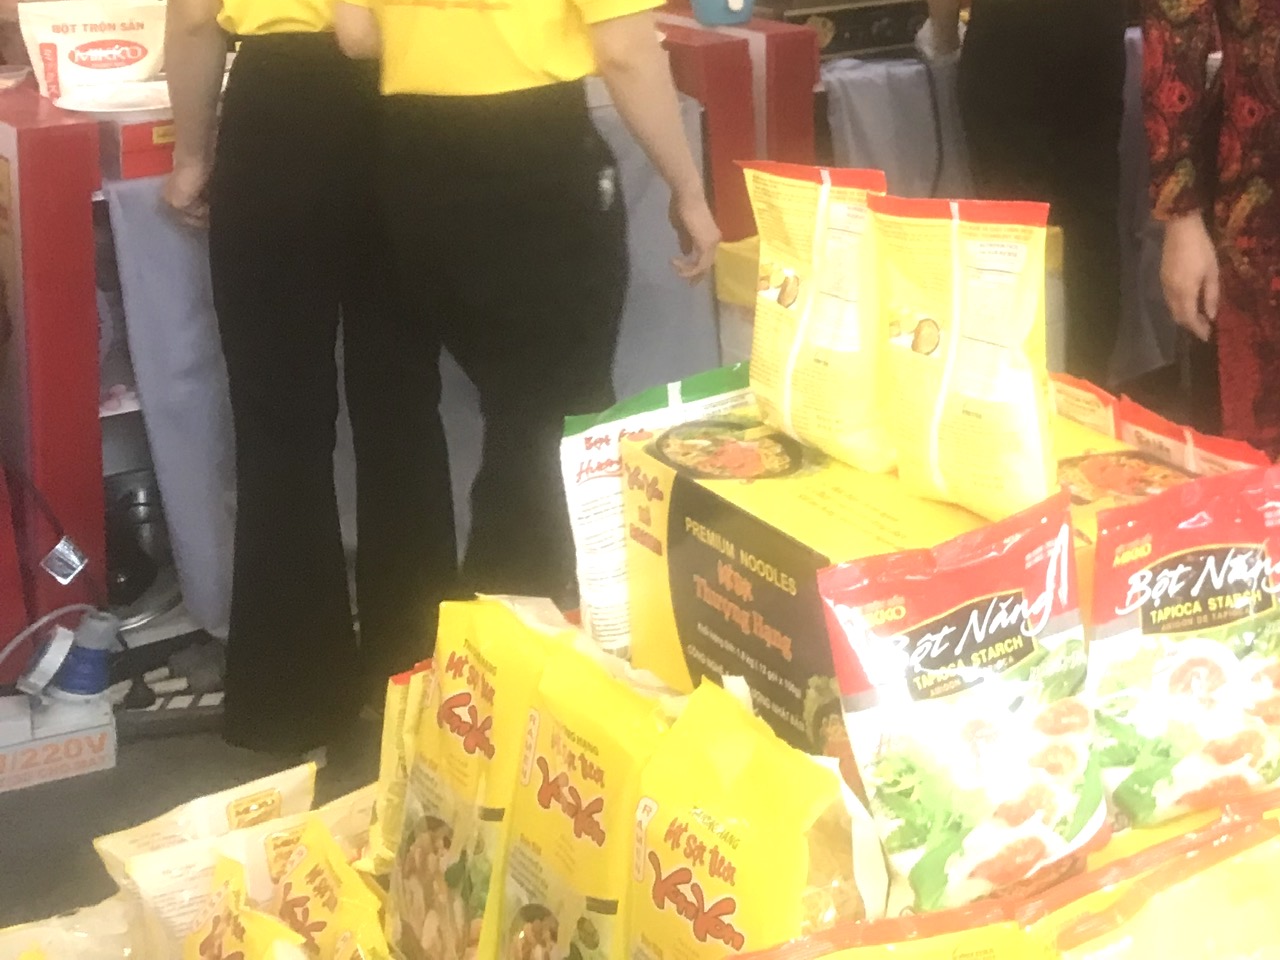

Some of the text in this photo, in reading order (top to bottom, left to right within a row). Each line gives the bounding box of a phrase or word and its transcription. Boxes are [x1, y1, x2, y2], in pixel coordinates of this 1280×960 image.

[685, 516, 736, 560] PREMIUM
[740, 549, 797, 597] NOODLES
[1151, 601, 1203, 624] TAPIOCA
[971, 635, 1024, 668] STARCH
